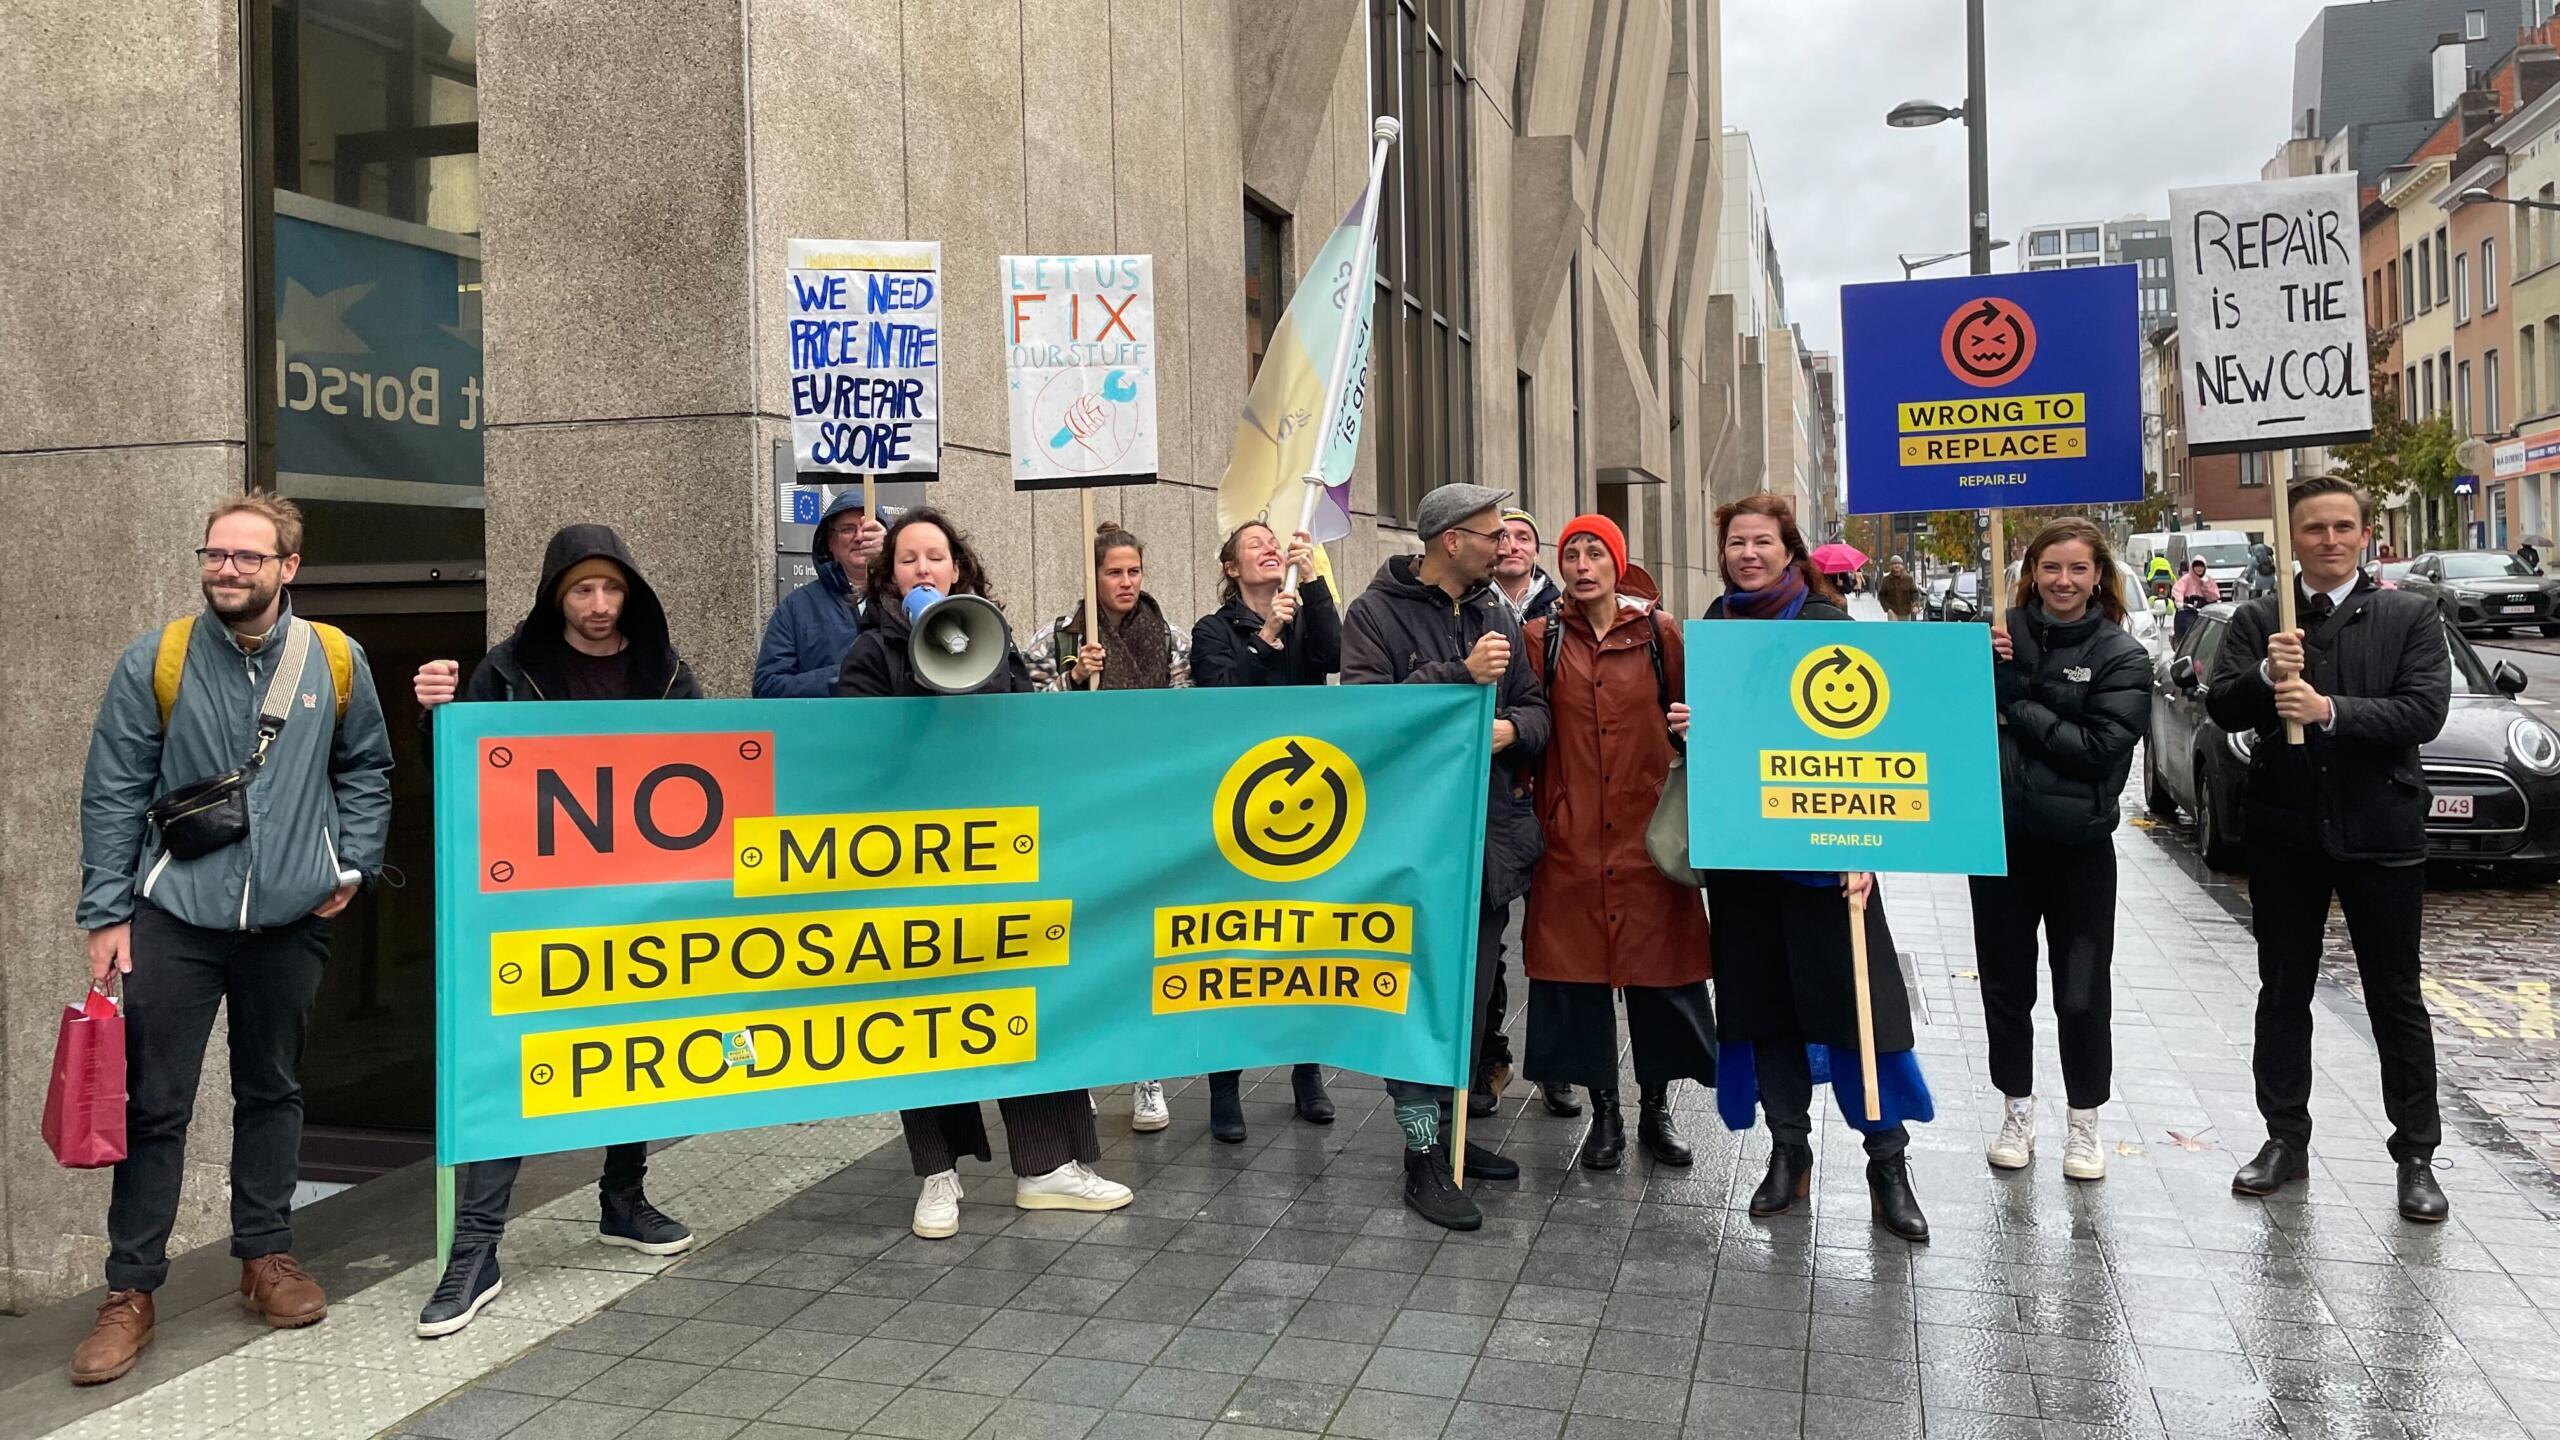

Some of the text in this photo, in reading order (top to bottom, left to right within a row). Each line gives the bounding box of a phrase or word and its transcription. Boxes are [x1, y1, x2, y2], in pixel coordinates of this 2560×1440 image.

[794, 273, 933, 314] WE NEED
[1010, 258, 1141, 290] LET US
[1011, 293, 1138, 344] FIX
[2280, 280, 2346, 322] THE
[790, 320, 858, 369] PRICE
[1013, 343, 1148, 367] OUR STUFF
[2196, 342, 2365, 406] NEW COOL
[792, 374, 923, 419] EU REPAIR
[1909, 398, 2074, 427] WRONG TO
[812, 422, 912, 468] SCORE
[1927, 434, 2058, 460] REPLACE
[1959, 473, 2027, 487] REPAIR.EU
[793, 564, 804, 576] DG
[1771, 755, 1916, 779] RIGHT TO
[536, 762, 725, 857] NO
[1791, 792, 1896, 815] REPAIR
[2437, 799, 2469, 814] 049
[779, 820, 998, 882] MORE
[1811, 833, 1883, 847] REPAIR.EU
[1171, 909, 1396, 948] RIGHT TO
[540, 914, 1031, 998] DISPOSABLE
[1199, 966, 1360, 1002] REPAIR
[571, 1003, 997, 1098] PRODUCTS
